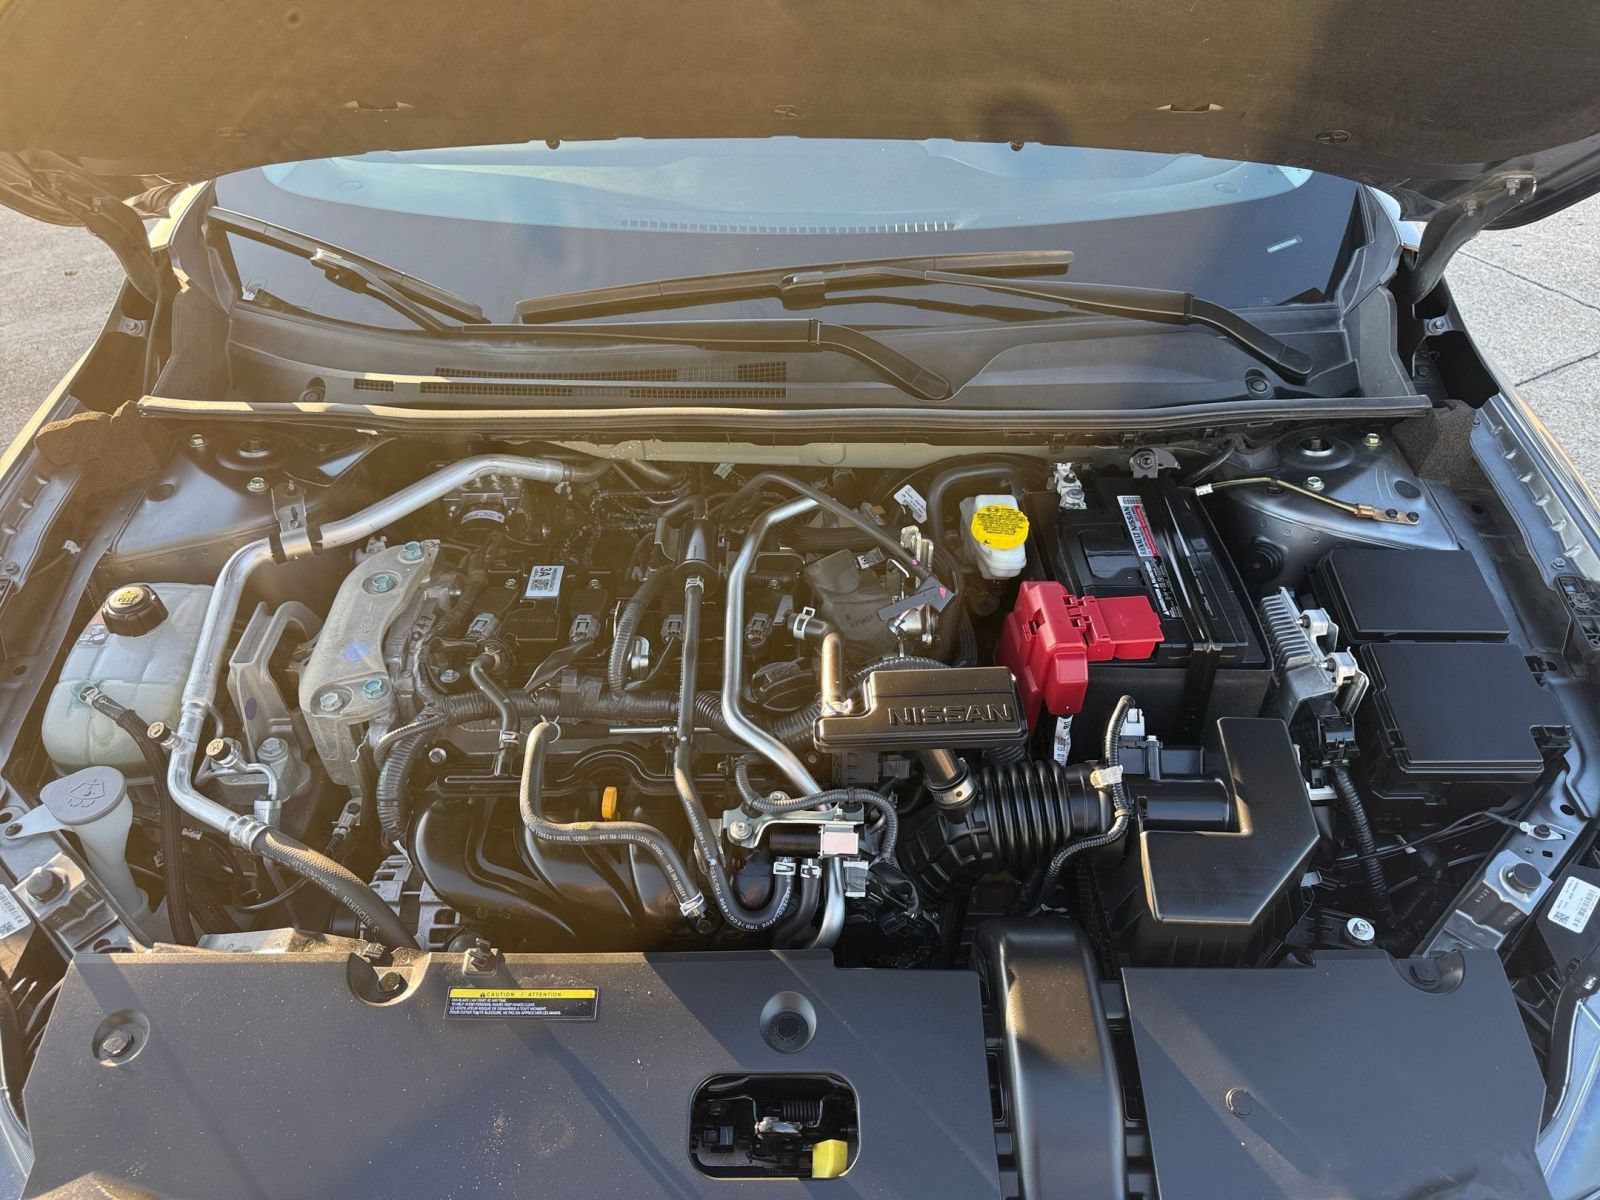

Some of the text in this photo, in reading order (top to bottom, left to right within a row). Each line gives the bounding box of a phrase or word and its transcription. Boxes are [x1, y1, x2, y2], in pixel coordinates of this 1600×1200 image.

[540, 567, 552, 578] 3A
[888, 703, 1014, 726] NISSAN
[342, 895, 375, 926] NICHIRIN
